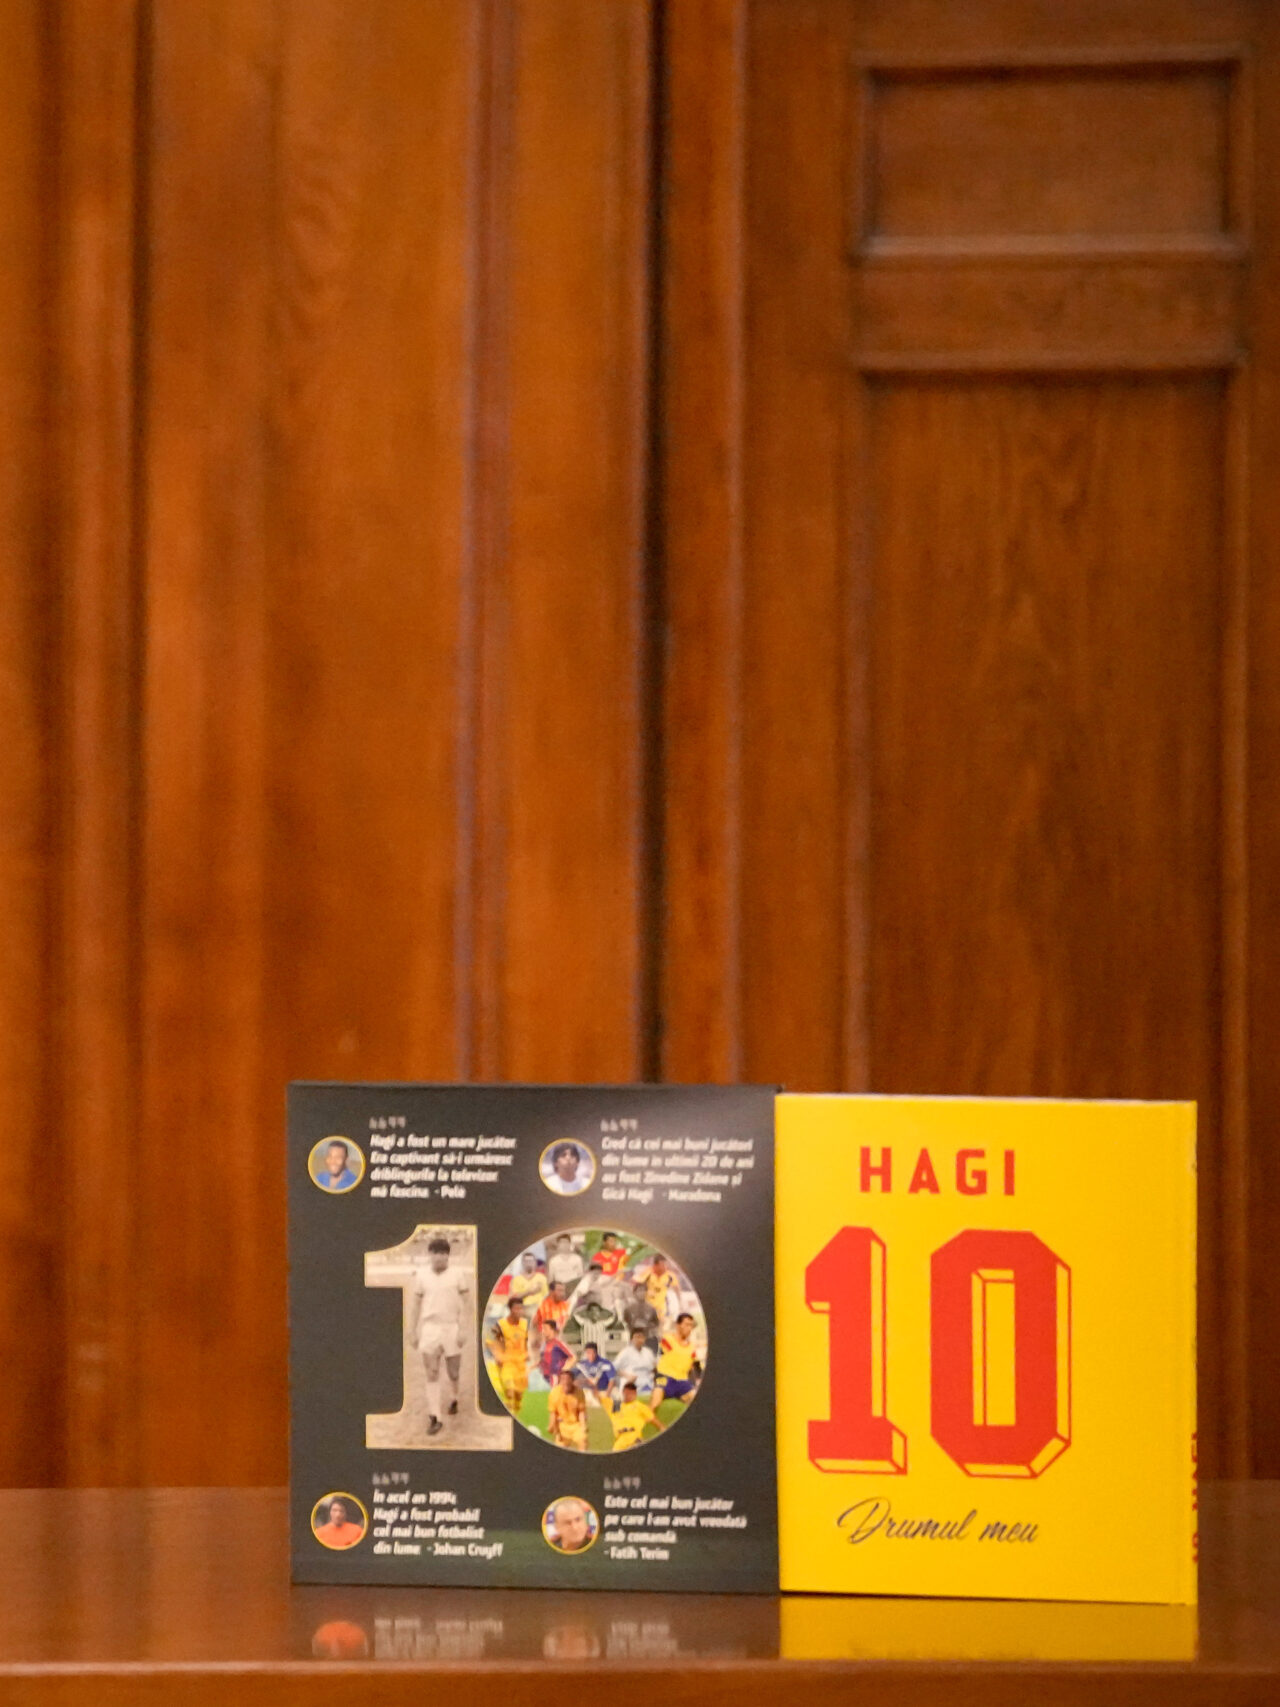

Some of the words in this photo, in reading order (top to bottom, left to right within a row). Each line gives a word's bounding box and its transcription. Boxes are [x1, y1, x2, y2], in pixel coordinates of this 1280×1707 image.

[370, 1133, 396, 1151] Hagi
[396, 1136, 405, 1148] a
[407, 1133, 430, 1148] fost
[431, 1136, 447, 1148] un
[448, 1136, 477, 1148] mare
[601, 1136, 628, 1150] Cred
[662, 1137, 683, 1151] mai
[683, 1136, 711, 1151] buni
[370, 1150, 389, 1164] Era
[389, 1151, 441, 1167] captivant
[601, 1153, 620, 1167] din
[622, 1153, 650, 1167] lume
[664, 1153, 700, 1168] ultimii
[700, 1155, 719, 1168] 20
[719, 1154, 735, 1168] de
[735, 1155, 755, 1169] ani
[370, 1167, 436, 1185] driblingurile
[437, 1167, 449, 1182] la
[450, 1168, 499, 1182] televizor
[601, 1173, 617, 1184] au
[618, 1169, 642, 1184] fost
[642, 1170, 691, 1184] Zinedine
[691, 1171, 729, 1185] Zidane
[859, 1146, 1016, 1196] HAGI
[389, 1183, 430, 1199] fascina
[627, 1187, 654, 1205] Hagi
[805, 1225, 1072, 1480] 10
[386, 1489, 411, 1504] acel
[411, 1493, 427, 1504] an
[604, 1494, 629, 1509] Este
[630, 1494, 649, 1509] cel
[649, 1495, 671, 1510] mai
[671, 1495, 694, 1510] bun
[373, 1507, 400, 1525] Hagi
[400, 1510, 409, 1521] a
[410, 1506, 433, 1522] fost
[434, 1507, 481, 1524] probabil
[604, 1513, 620, 1528] pe
[620, 1514, 646, 1526] care
[671, 1514, 697, 1527] avut
[836, 1496, 978, 1545] Drumul
[978, 1521, 1039, 1543] meu
[373, 1523, 391, 1538] cel
[392, 1524, 413, 1538] mai
[413, 1524, 437, 1538] bun
[437, 1524, 485, 1540] fotbalist
[604, 1529, 626, 1542] sub
[373, 1541, 392, 1555] din
[393, 1541, 422, 1555] lume
[467, 1542, 504, 1560] Cruyff
[640, 1546, 670, 1561] Terim
